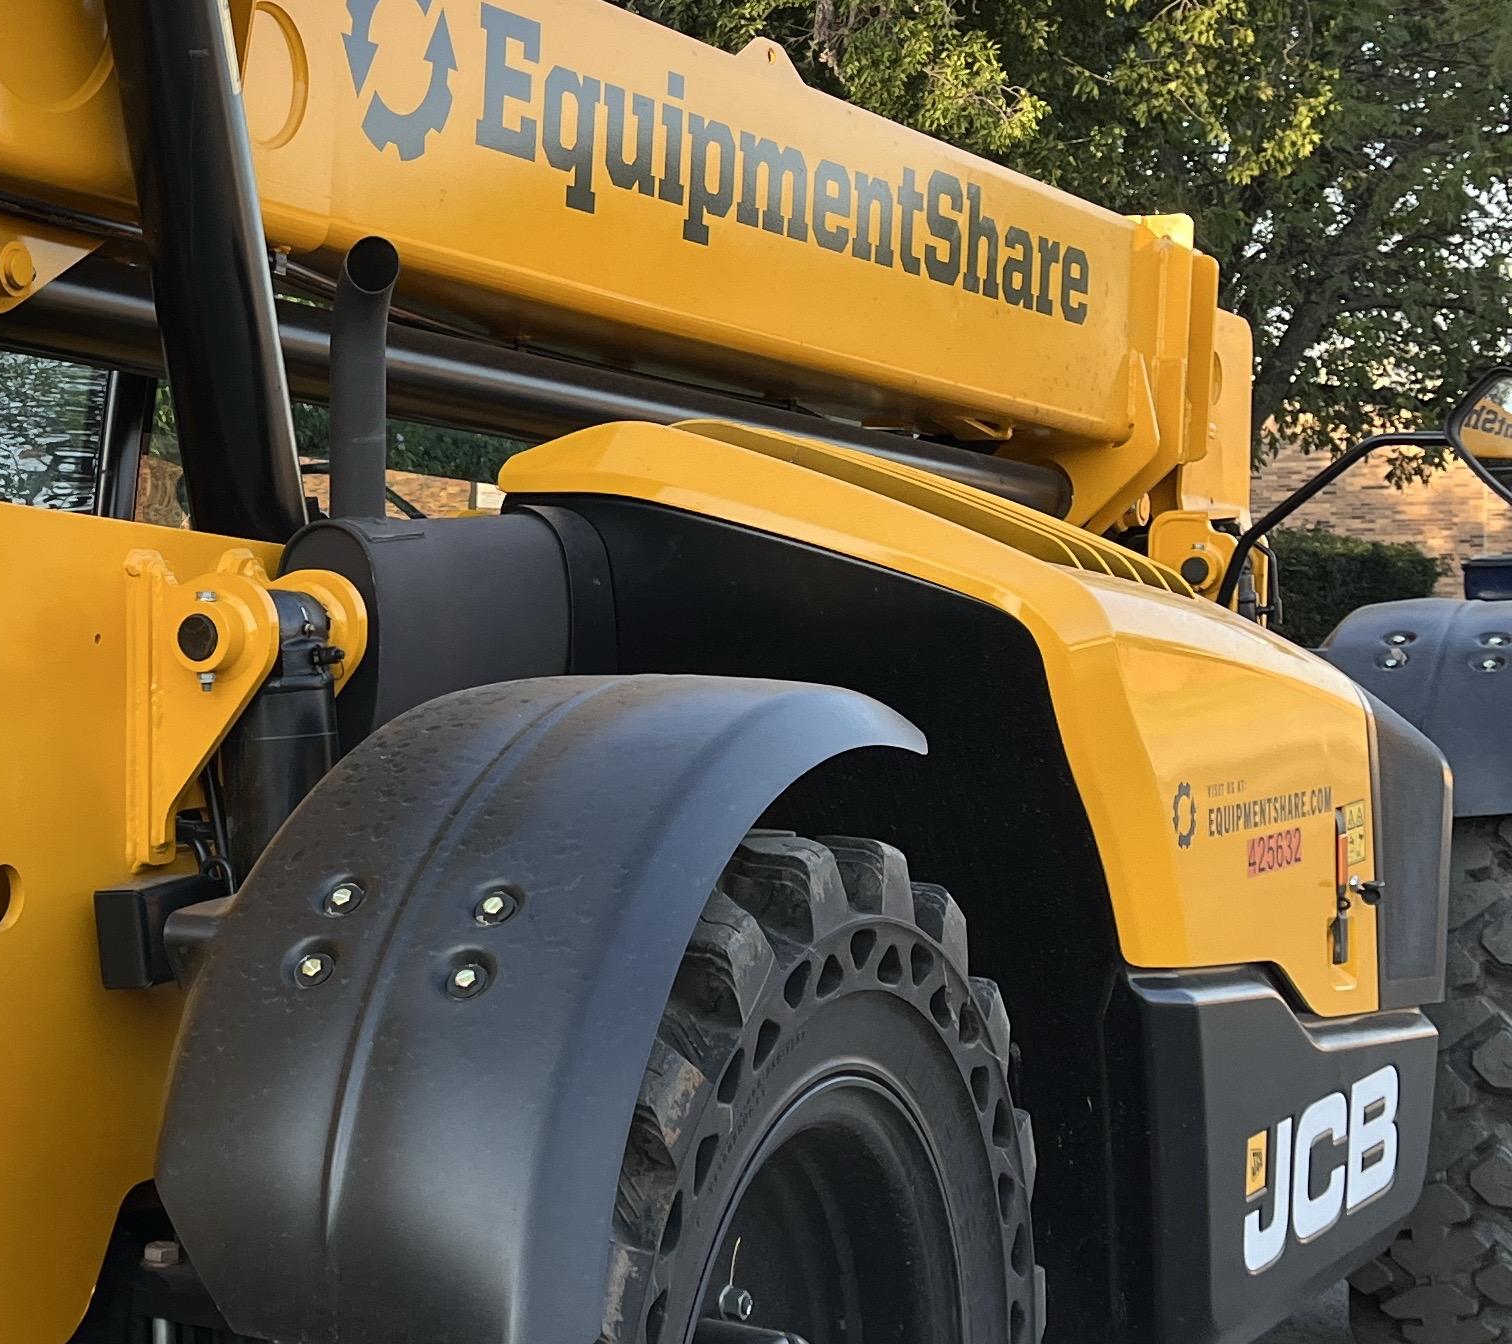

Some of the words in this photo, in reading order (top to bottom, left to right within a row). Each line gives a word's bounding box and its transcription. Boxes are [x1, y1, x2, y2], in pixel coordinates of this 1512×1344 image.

[476, 2, 1090, 325] EquipmentShare
[1208, 786, 1332, 837] EQUIPMENTSHARE.COM
[1248, 828, 1302, 874] 425632
[1243, 1064, 1400, 1275] JCB
